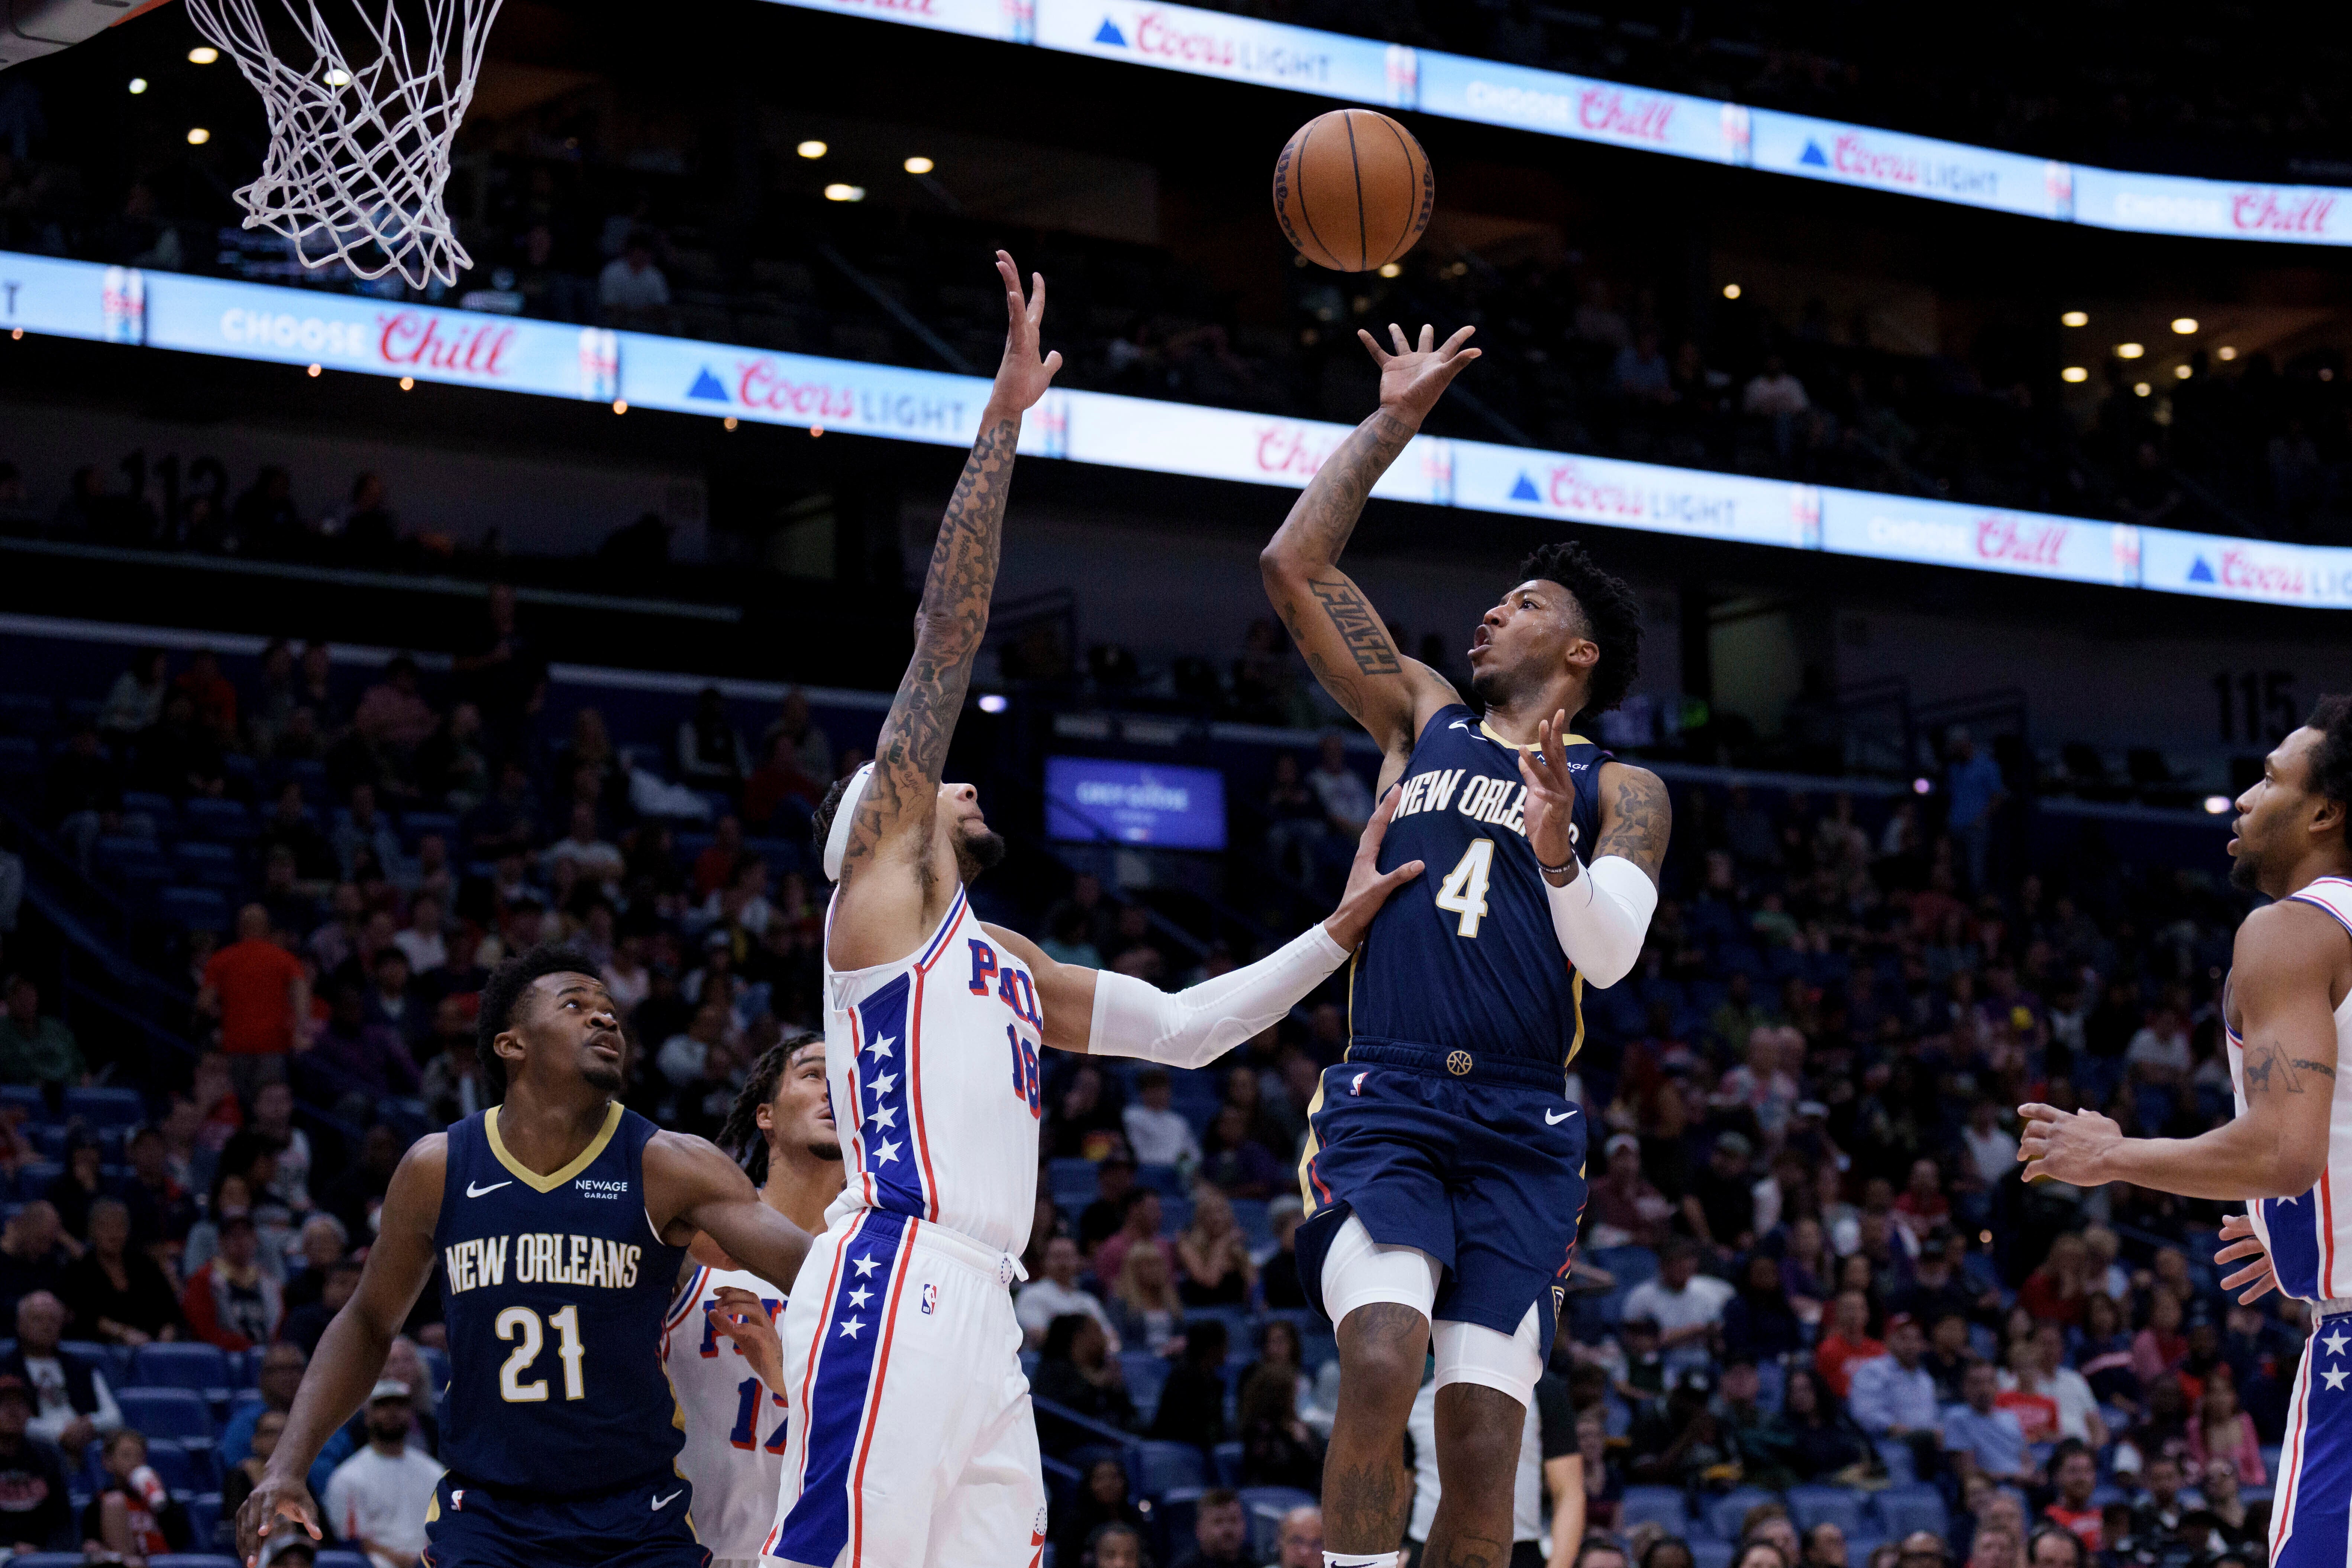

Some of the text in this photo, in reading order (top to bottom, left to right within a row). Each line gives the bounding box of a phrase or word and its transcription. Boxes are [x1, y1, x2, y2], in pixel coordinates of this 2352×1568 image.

[1135, 11, 1234, 66] Coors
[1577, 85, 1675, 140] Chill
[2231, 189, 2336, 233] Chill
[221, 307, 368, 357] CHOOSE
[375, 309, 518, 376] Chill
[736, 354, 965, 432] Coors LIGHT
[1975, 515, 2069, 567] Chill
[2213, 673, 2296, 743] 115
[1390, 769, 1466, 824] NEW
[1436, 838, 1494, 938] 4
[1007, 1022, 1040, 1120] 18
[575, 1180, 627, 1192] NEWAGE
[445, 1233, 642, 1296] NEW ORLEANS
[495, 1305, 585, 1403] 21
